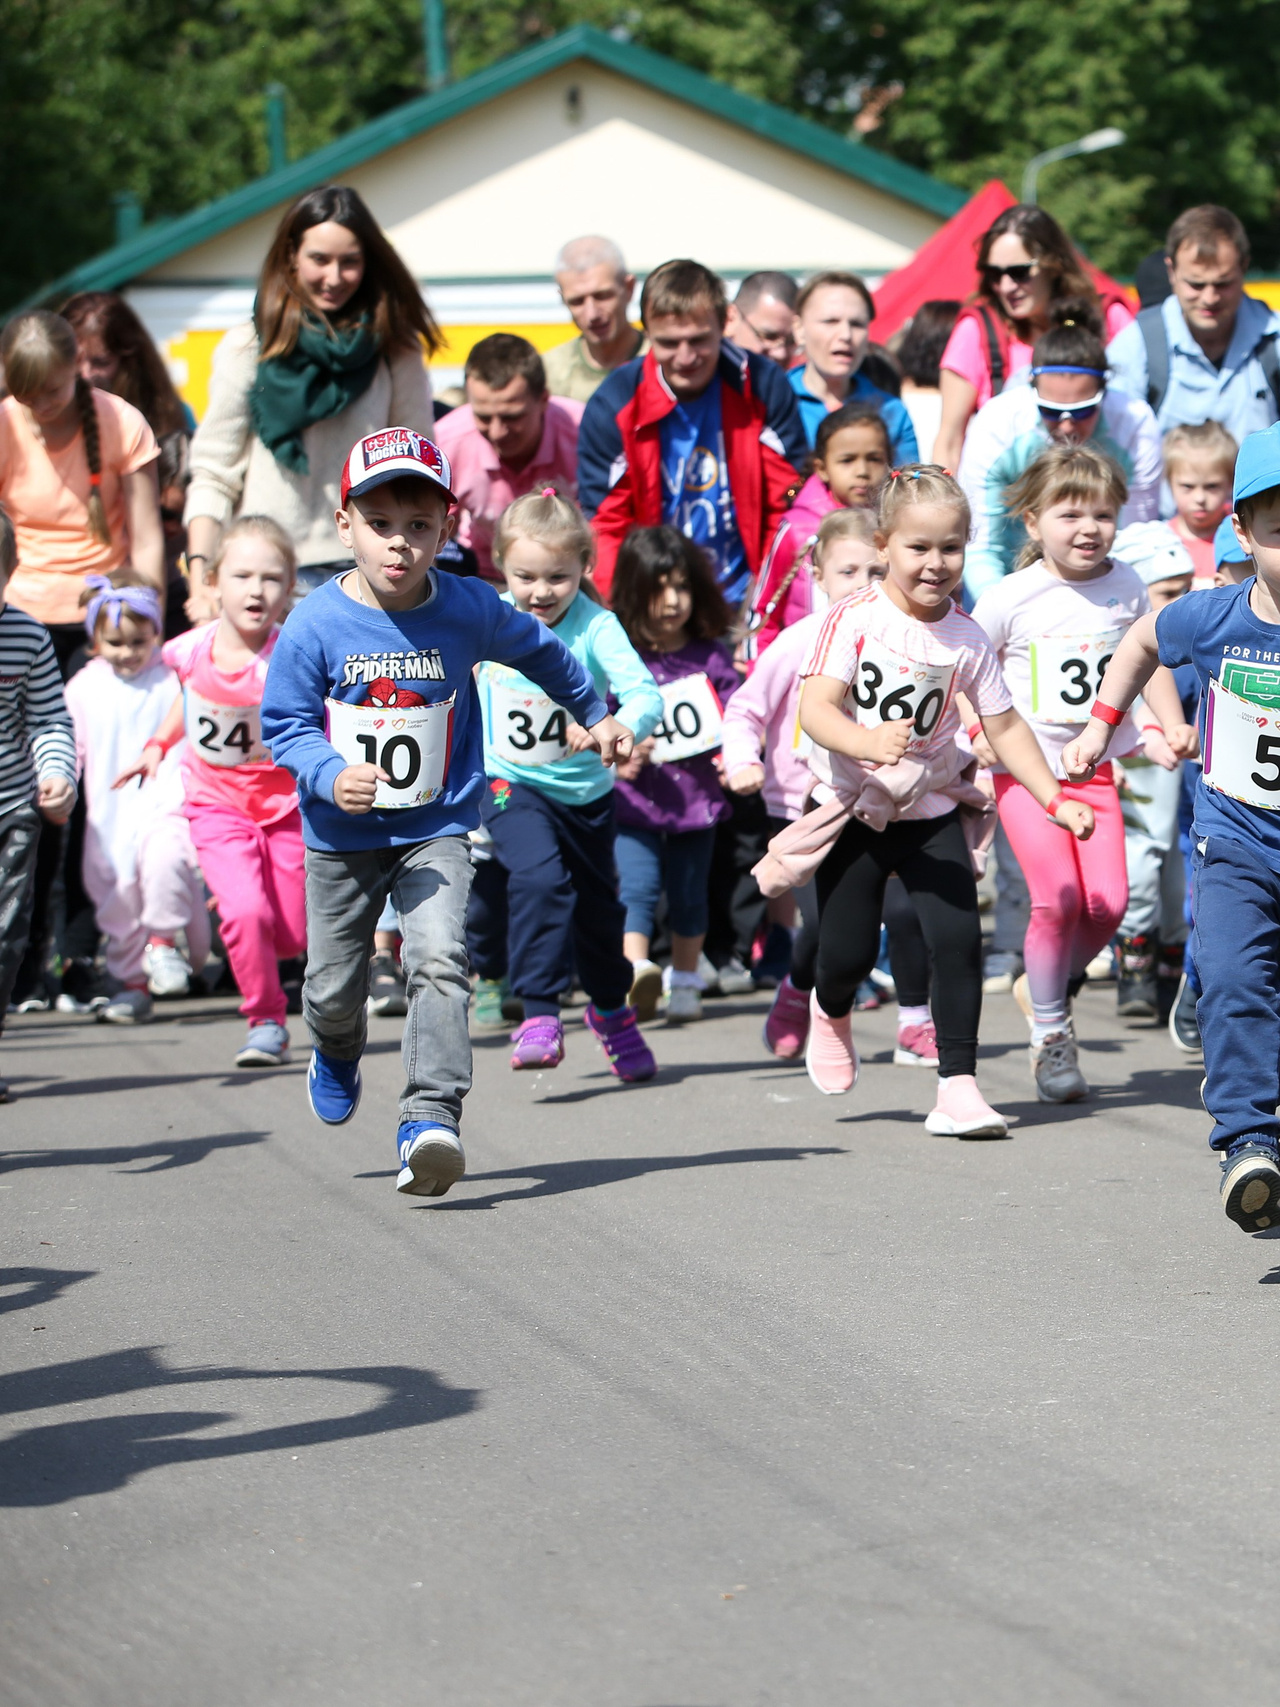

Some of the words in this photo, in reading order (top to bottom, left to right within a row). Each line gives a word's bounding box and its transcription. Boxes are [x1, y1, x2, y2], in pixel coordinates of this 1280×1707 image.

[368, 444, 411, 465] HOCKEY
[345, 648, 441, 662] ULTIMATE
[1223, 645, 1251, 659] FOR
[1255, 650, 1280, 663] THE
[340, 656, 446, 688] SPIDER-MAN
[852, 661, 945, 737] 360
[198, 716, 256, 755] 24
[508, 709, 568, 751] 34
[356, 733, 422, 790] 10
